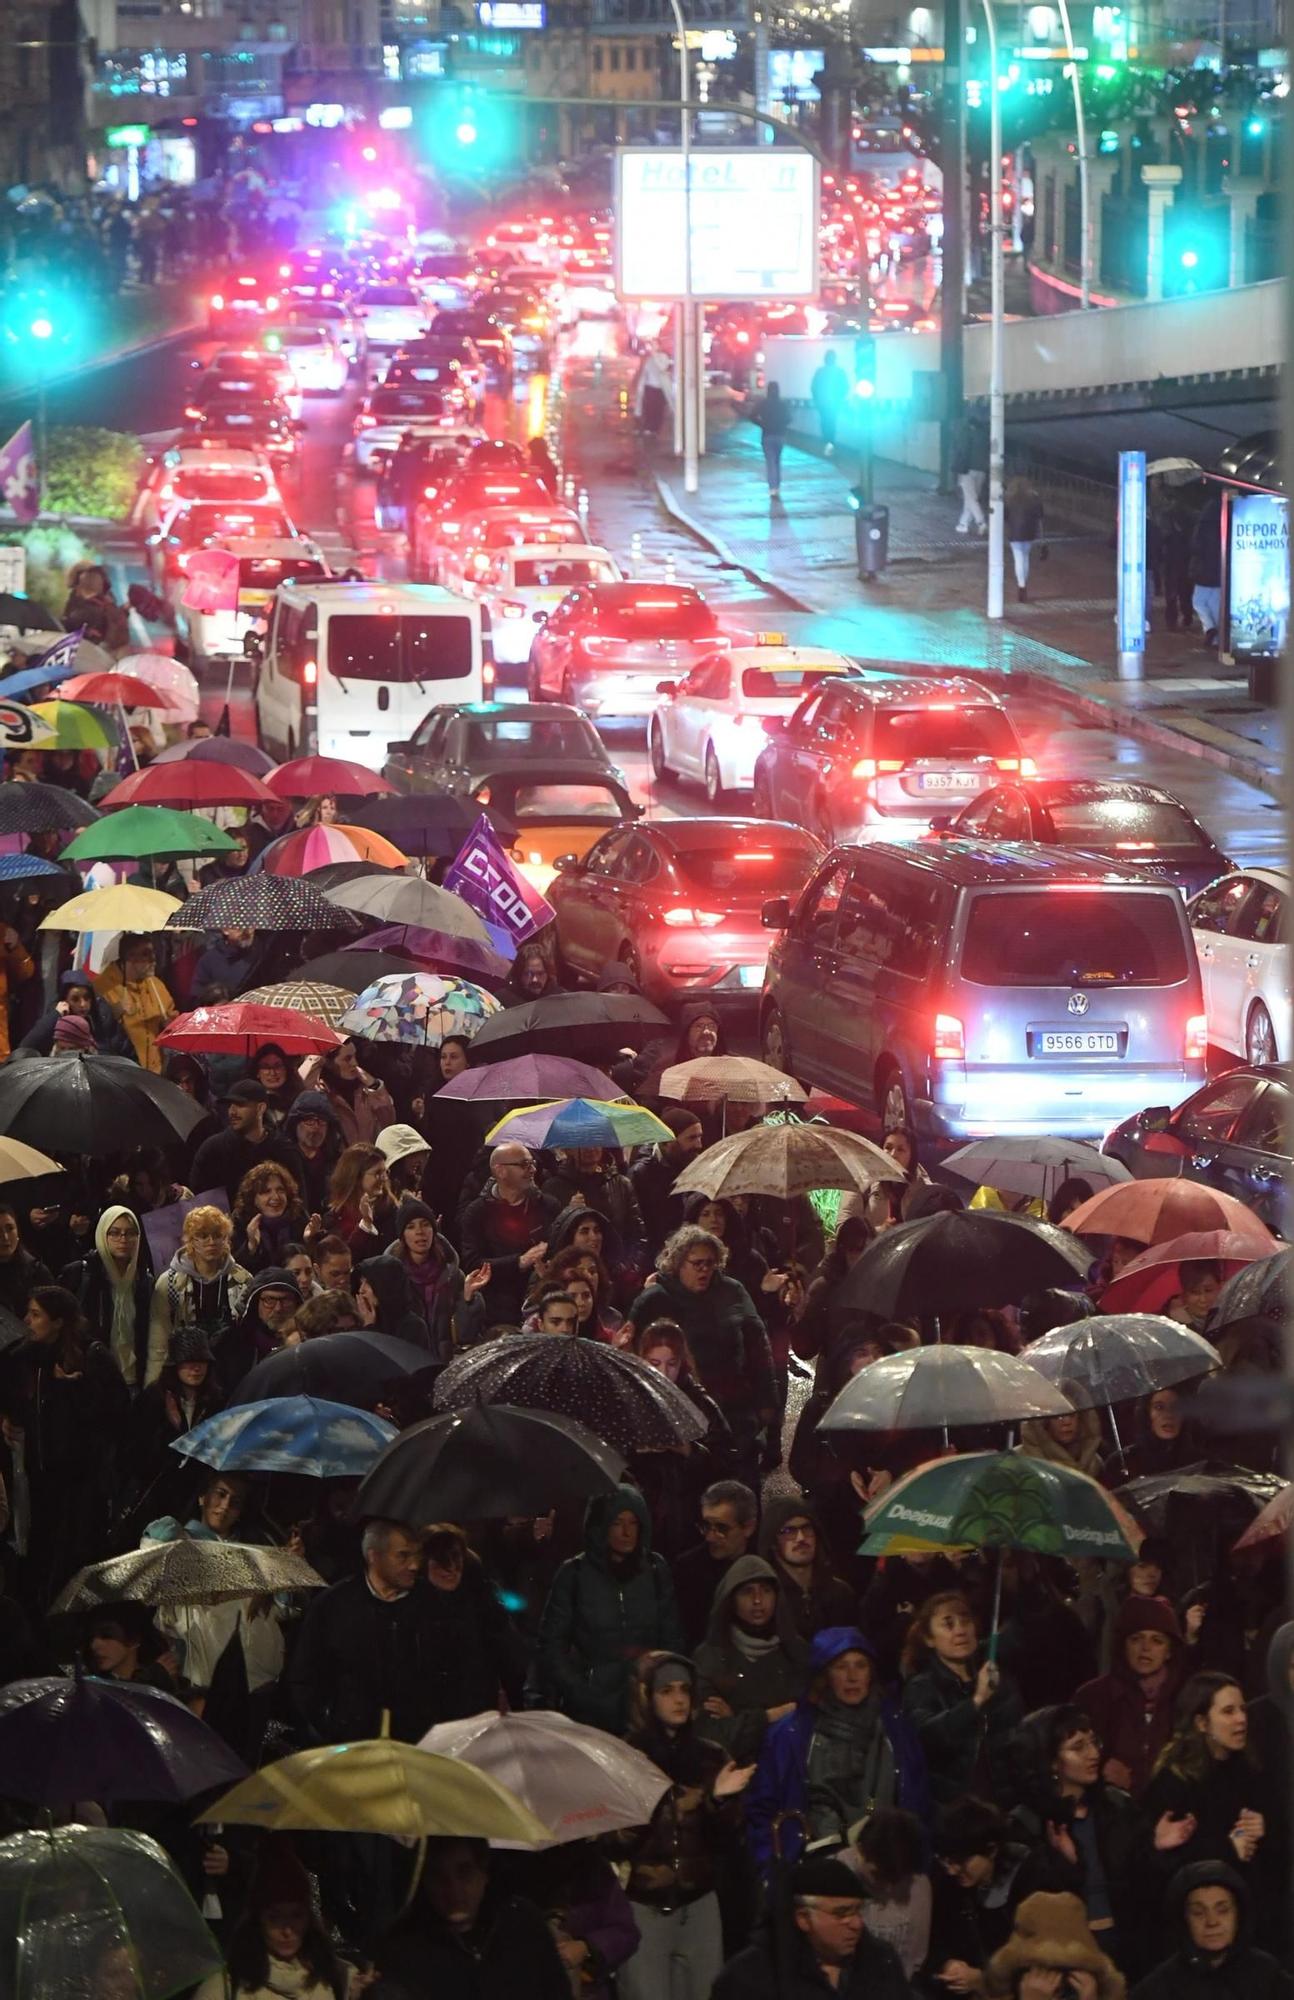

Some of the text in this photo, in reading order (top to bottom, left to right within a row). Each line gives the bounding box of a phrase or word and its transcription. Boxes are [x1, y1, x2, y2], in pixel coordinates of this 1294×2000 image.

[1046, 1035, 1114, 1049] 9566 GTD
[887, 1503, 952, 1529] Desigual
[1062, 1523, 1121, 1546] Desigual
